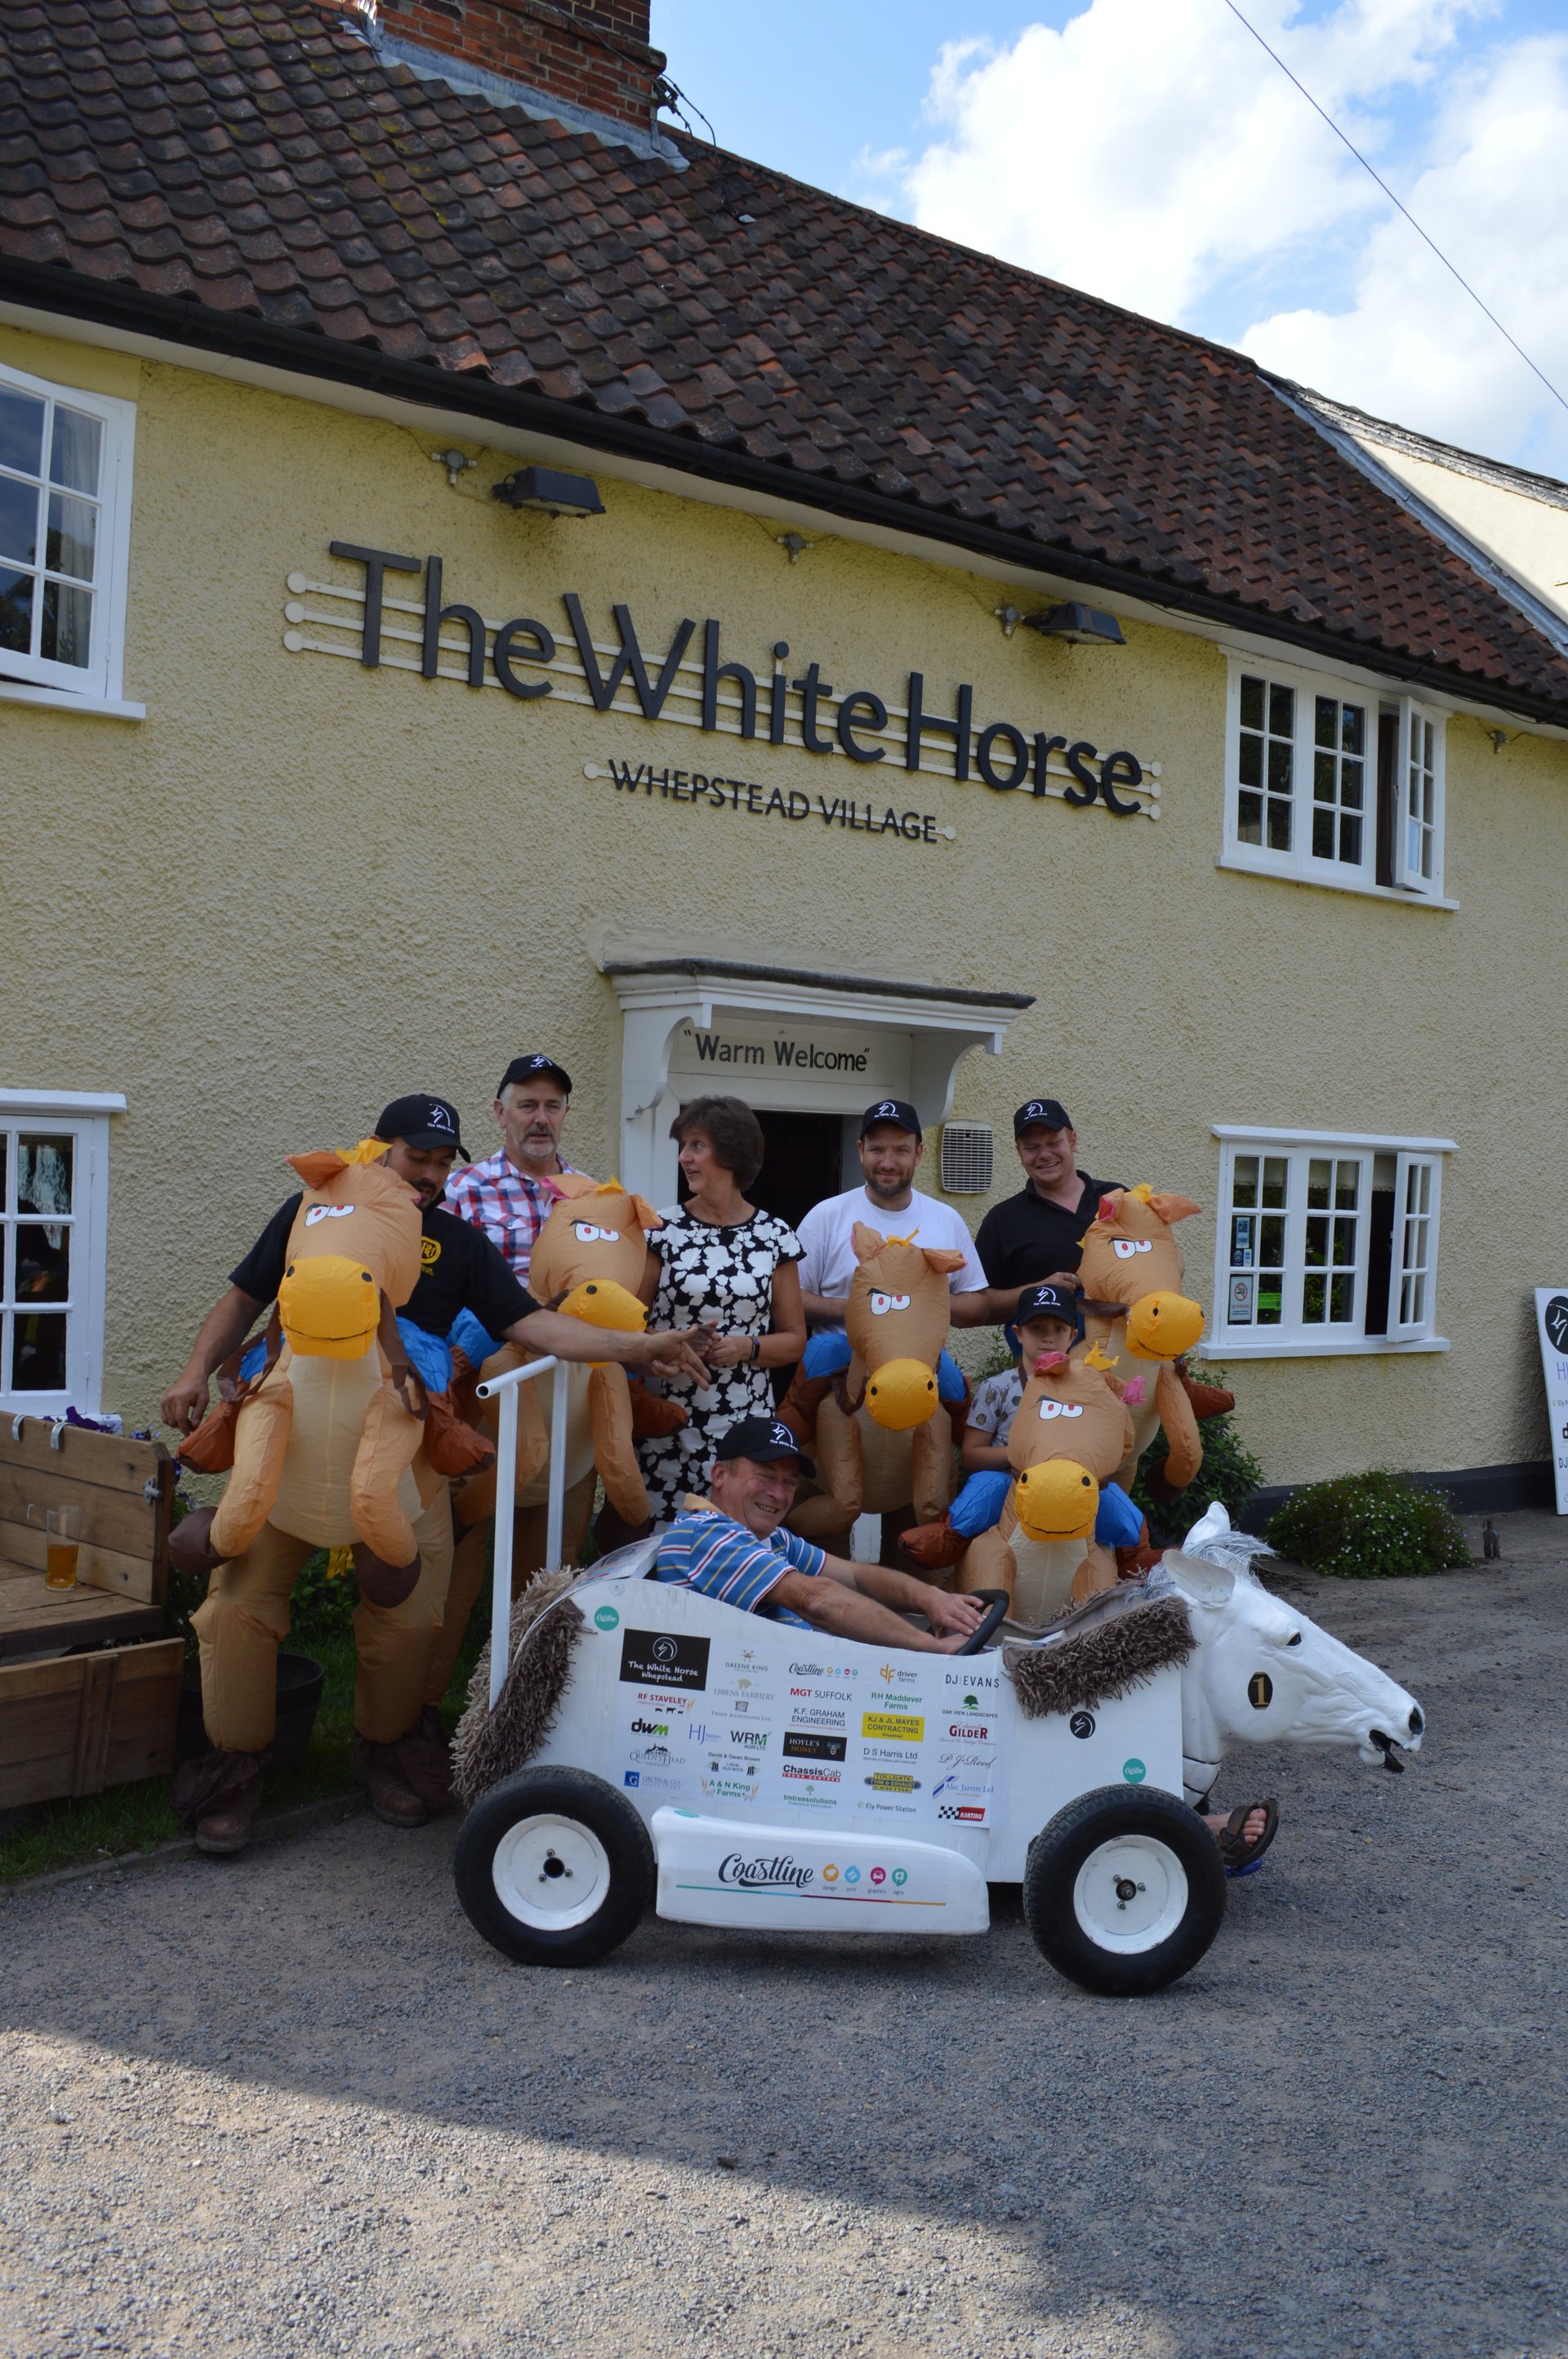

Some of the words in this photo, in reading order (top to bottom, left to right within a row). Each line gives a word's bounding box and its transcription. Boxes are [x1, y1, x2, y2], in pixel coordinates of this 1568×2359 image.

[330, 540, 556, 699] The
[563, 591, 888, 763] White
[906, 671, 1143, 815] Horse
[608, 759, 810, 820] WHEPSTEAD
[818, 795, 938, 843] VILLAGE
[629, 1661, 644, 1670] The
[647, 1663, 671, 1673] White
[675, 1666, 698, 1676] Horse
[725, 1661, 750, 1670] GREENE
[789, 1662, 824, 1676] Coastline
[642, 1671, 683, 1683] Whepstead
[897, 1670, 917, 1678] driver
[964, 1675, 1000, 1688] EVANS
[791, 1688, 812, 1697] MGT
[814, 1690, 853, 1701] SUFFOLK
[1253, 1676, 1269, 1706] 1
[650, 1694, 687, 1705] STAVELEY
[885, 1693, 923, 1703] Maddever
[884, 1701, 908, 1710] Farms
[794, 1707, 807, 1715] K.F.
[809, 1709, 845, 1719] GRAHAM
[791, 1715, 845, 1727] ENGINEERING
[895, 1718, 920, 1726] MAYES
[689, 1724, 706, 1745] HJ
[867, 1724, 919, 1734] CONTRACTING
[730, 1730, 767, 1746] WRM
[789, 1738, 820, 1747] HOYLE'S
[791, 1746, 817, 1754] HONEY
[872, 1748, 878, 1756] S
[880, 1750, 903, 1758] Harris
[905, 1751, 918, 1759] Ltd
[783, 1764, 841, 1777] ChassisCab
[733, 1782, 751, 1791] King
[717, 1789, 741, 1797] Farms
[783, 1795, 837, 1805] tmtreesolutions
[719, 1853, 815, 1889] Coastline
